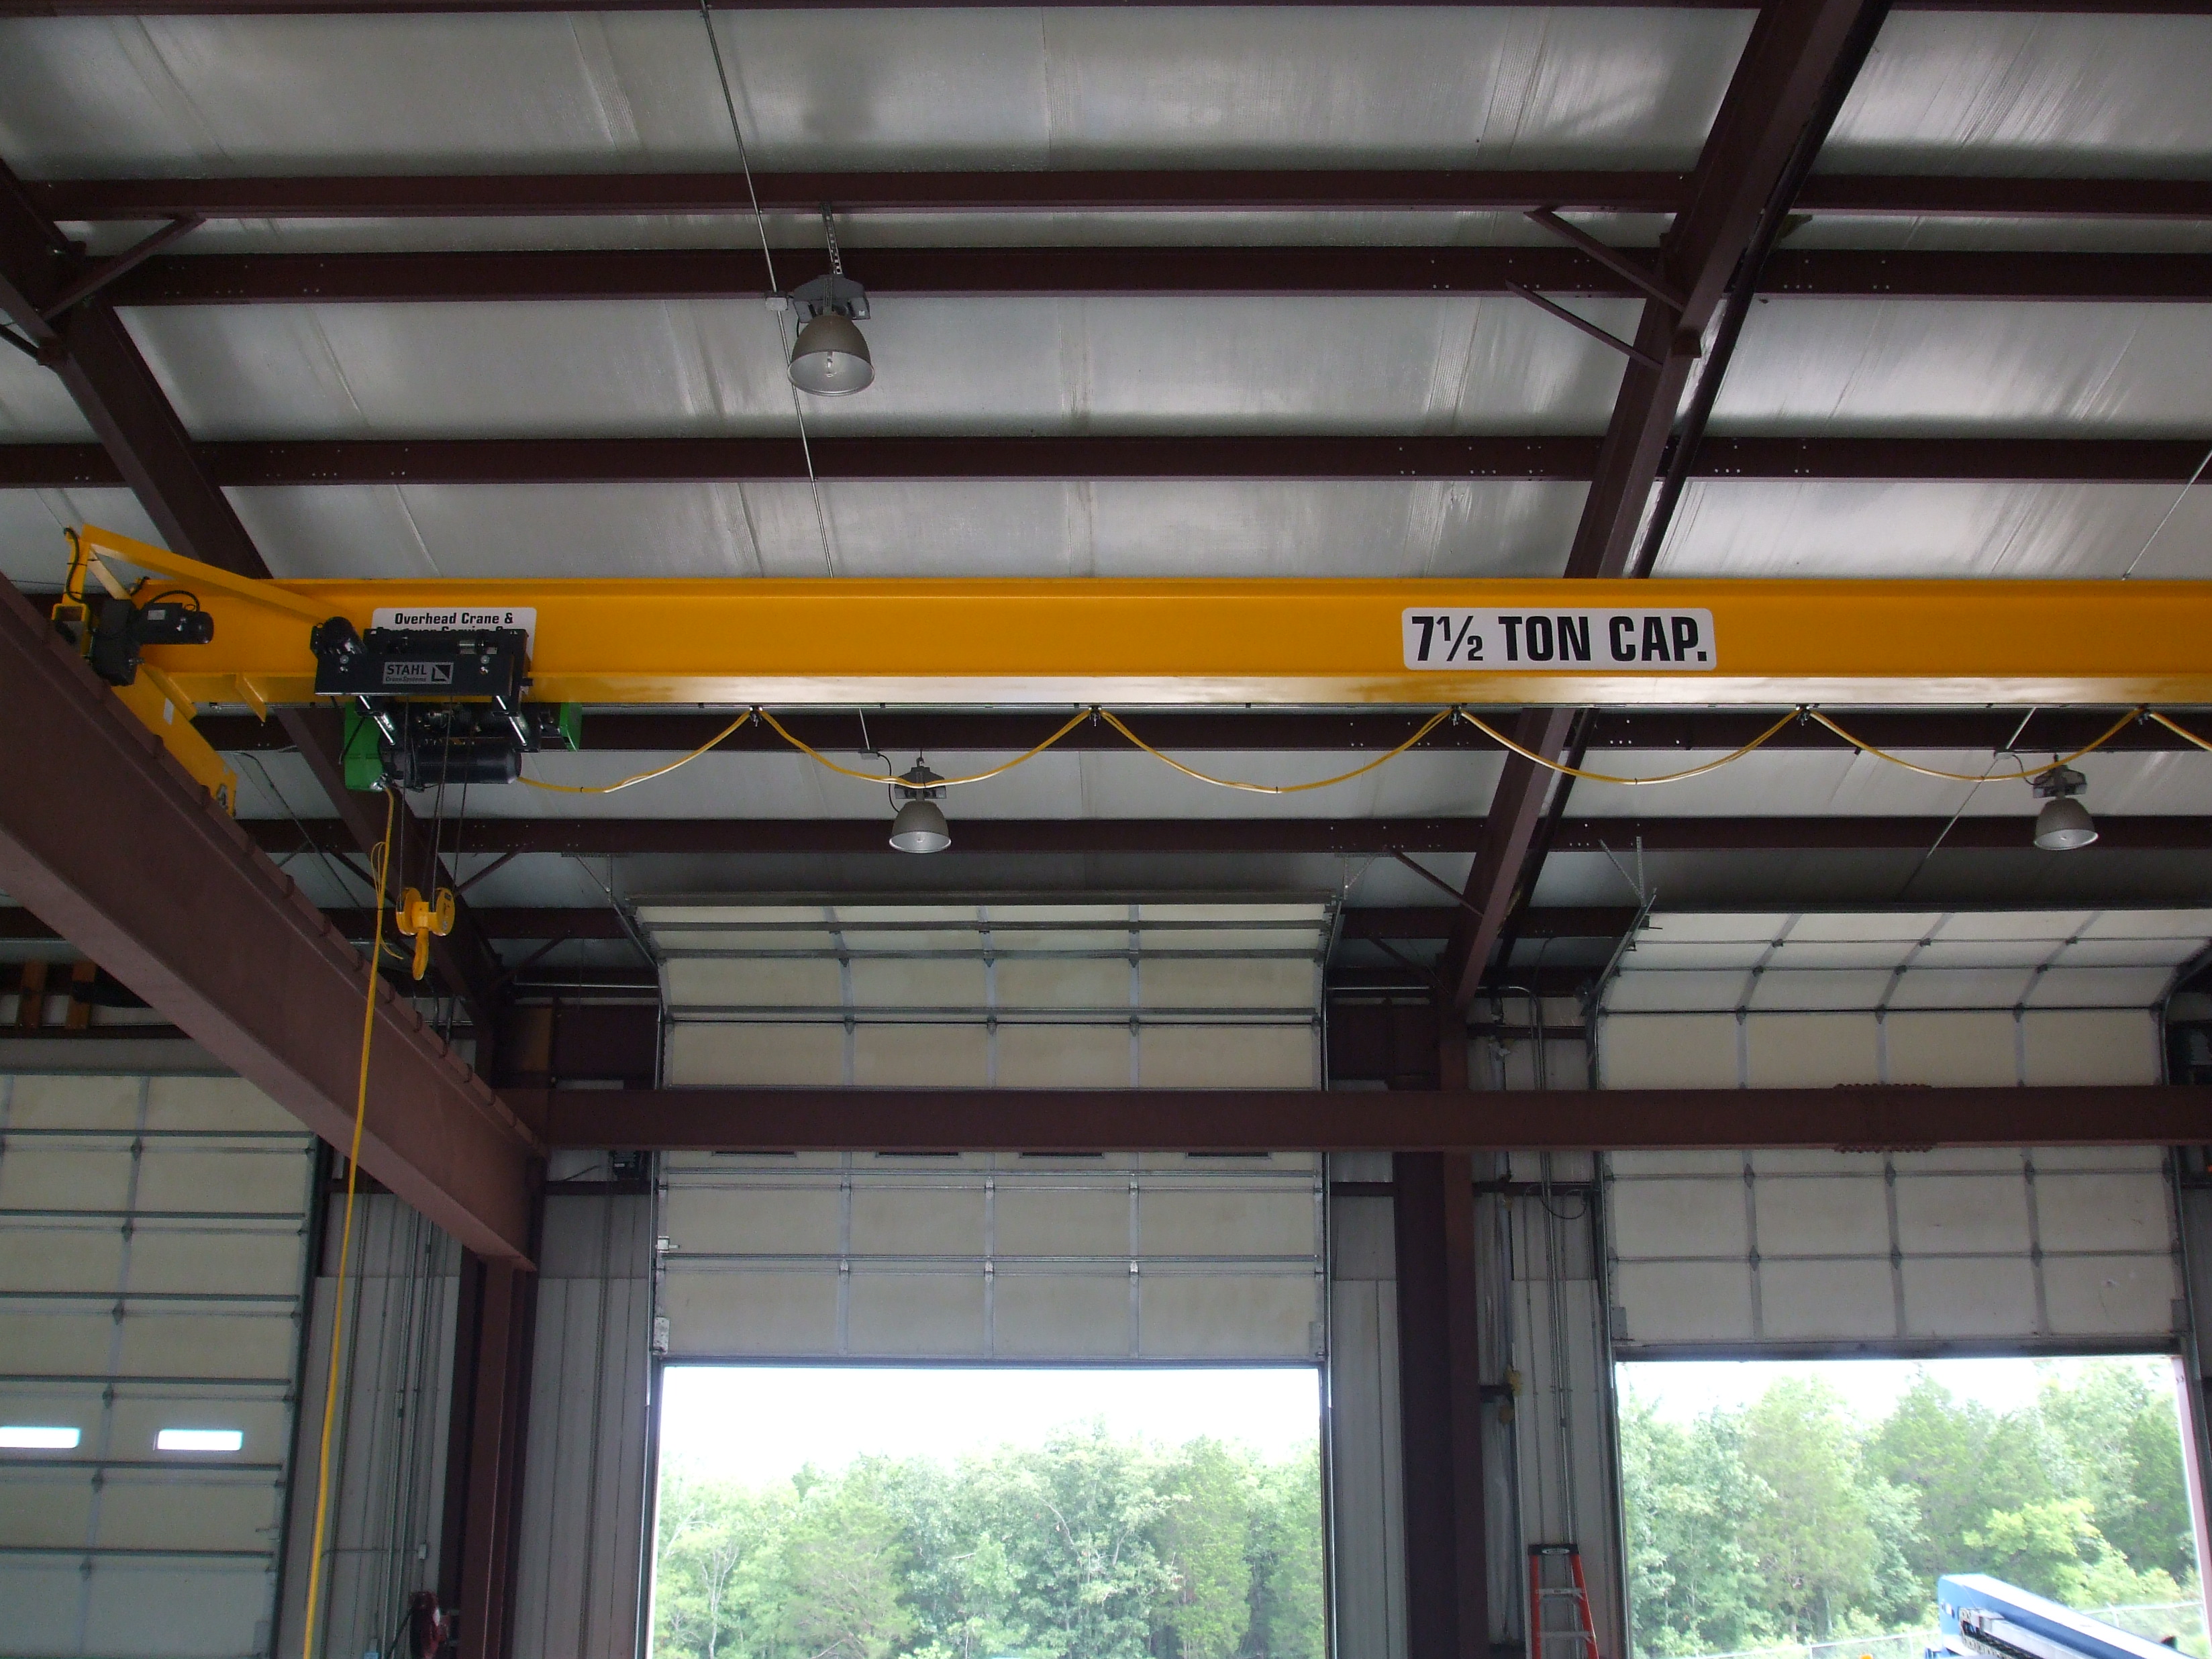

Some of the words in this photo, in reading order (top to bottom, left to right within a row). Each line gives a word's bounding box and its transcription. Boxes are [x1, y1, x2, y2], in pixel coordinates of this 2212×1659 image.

[395, 613, 457, 624] Overhead
[461, 613, 499, 624] Crane
[504, 612, 513, 624] &
[1498, 615, 1591, 662] TON
[1609, 615, 1707, 662] CAP.
[387, 664, 427, 675] STAHL
